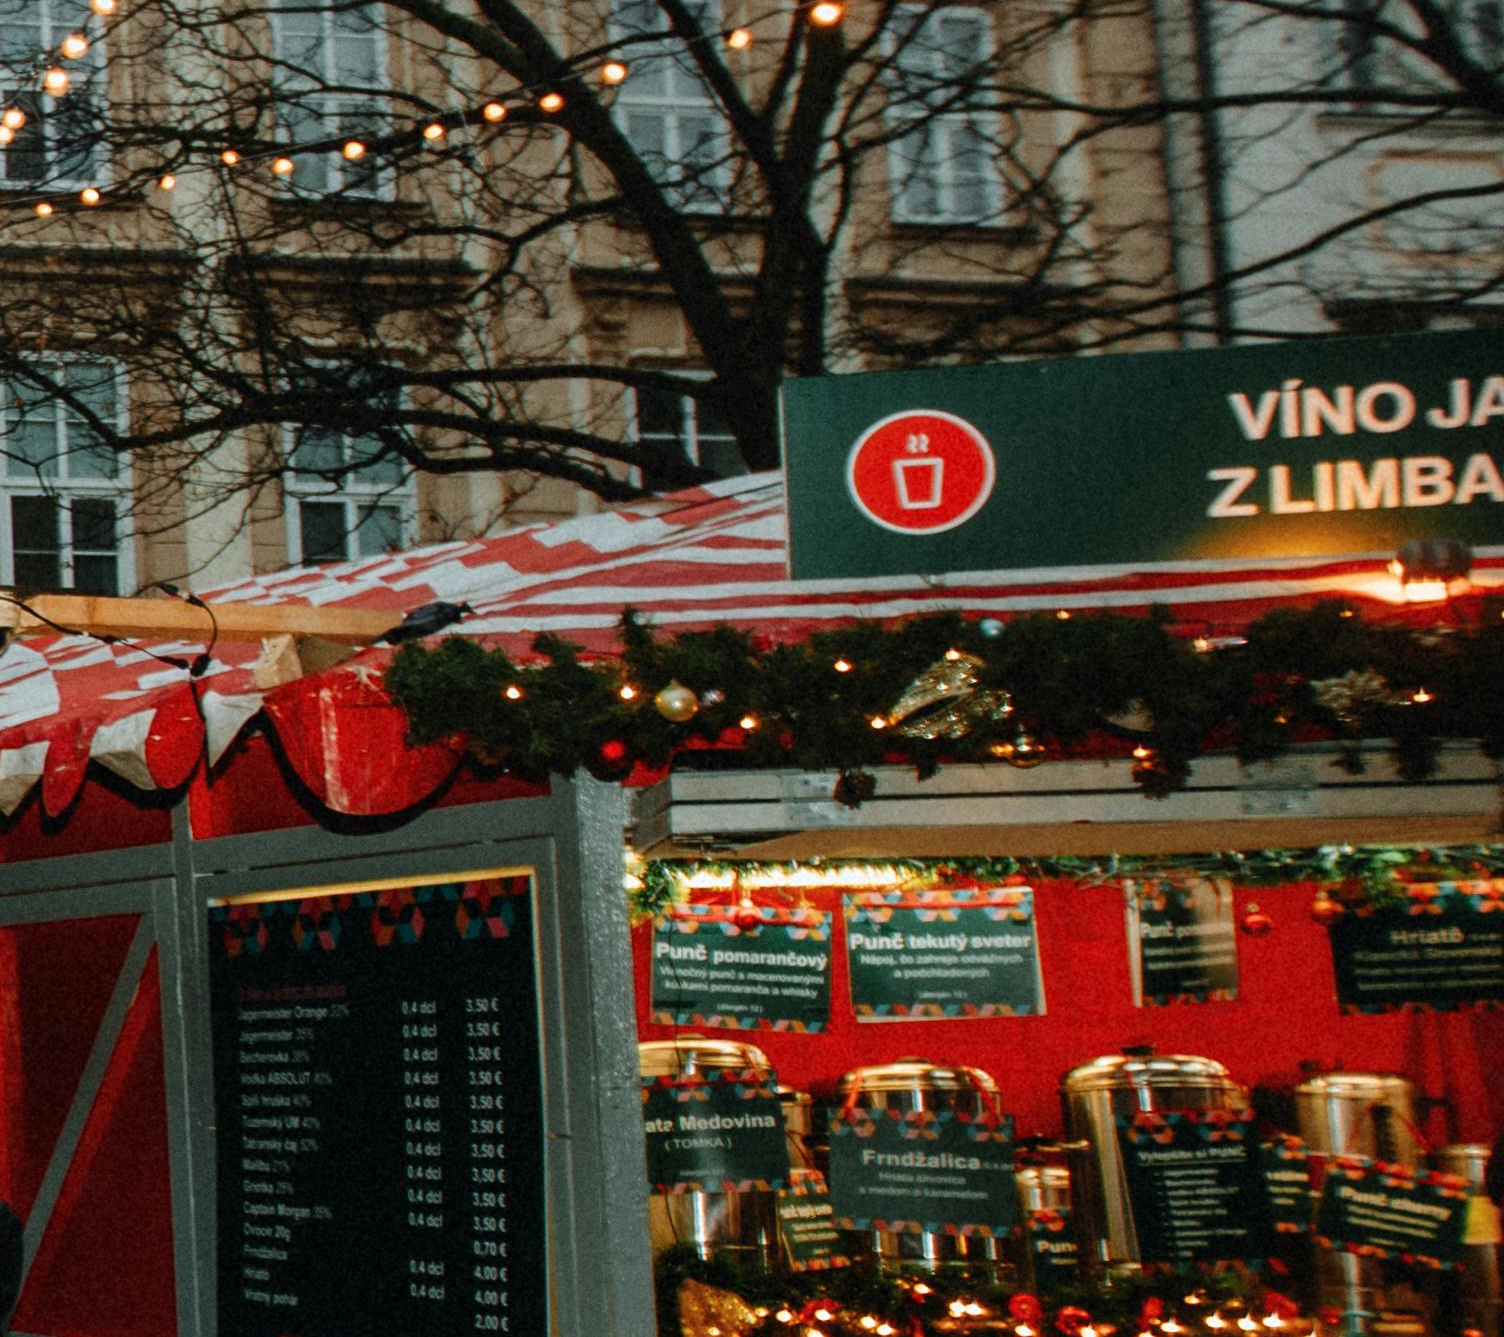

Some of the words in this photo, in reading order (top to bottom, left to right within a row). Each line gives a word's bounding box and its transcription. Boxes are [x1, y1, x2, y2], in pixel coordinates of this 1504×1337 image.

[1227, 377, 1417, 441] VÍNO
[1206, 466, 1260, 517] Z
[849, 932, 905, 950] Punč
[909, 933, 968, 952] tekutý
[972, 934, 1032, 949] sveter
[656, 942, 707, 961] Punč
[713, 949, 828, 971] pomarančový
[491, 997, 499, 1012] €
[492, 1022, 500, 1036] €
[493, 1047, 501, 1061] €
[495, 1071, 503, 1085] €
[496, 1095, 504, 1109] €
[496, 1120, 504, 1134] €
[678, 1113, 777, 1131] Medovina
[497, 1144, 505, 1159] €
[862, 1148, 982, 1171] Frndžalica
[498, 1169, 506, 1183] €
[498, 1193, 506, 1207] €
[499, 1218, 506, 1232] €
[499, 1242, 507, 1257] €
[500, 1267, 508, 1282] €
[501, 1292, 508, 1306] €
[501, 1316, 509, 1332] €
